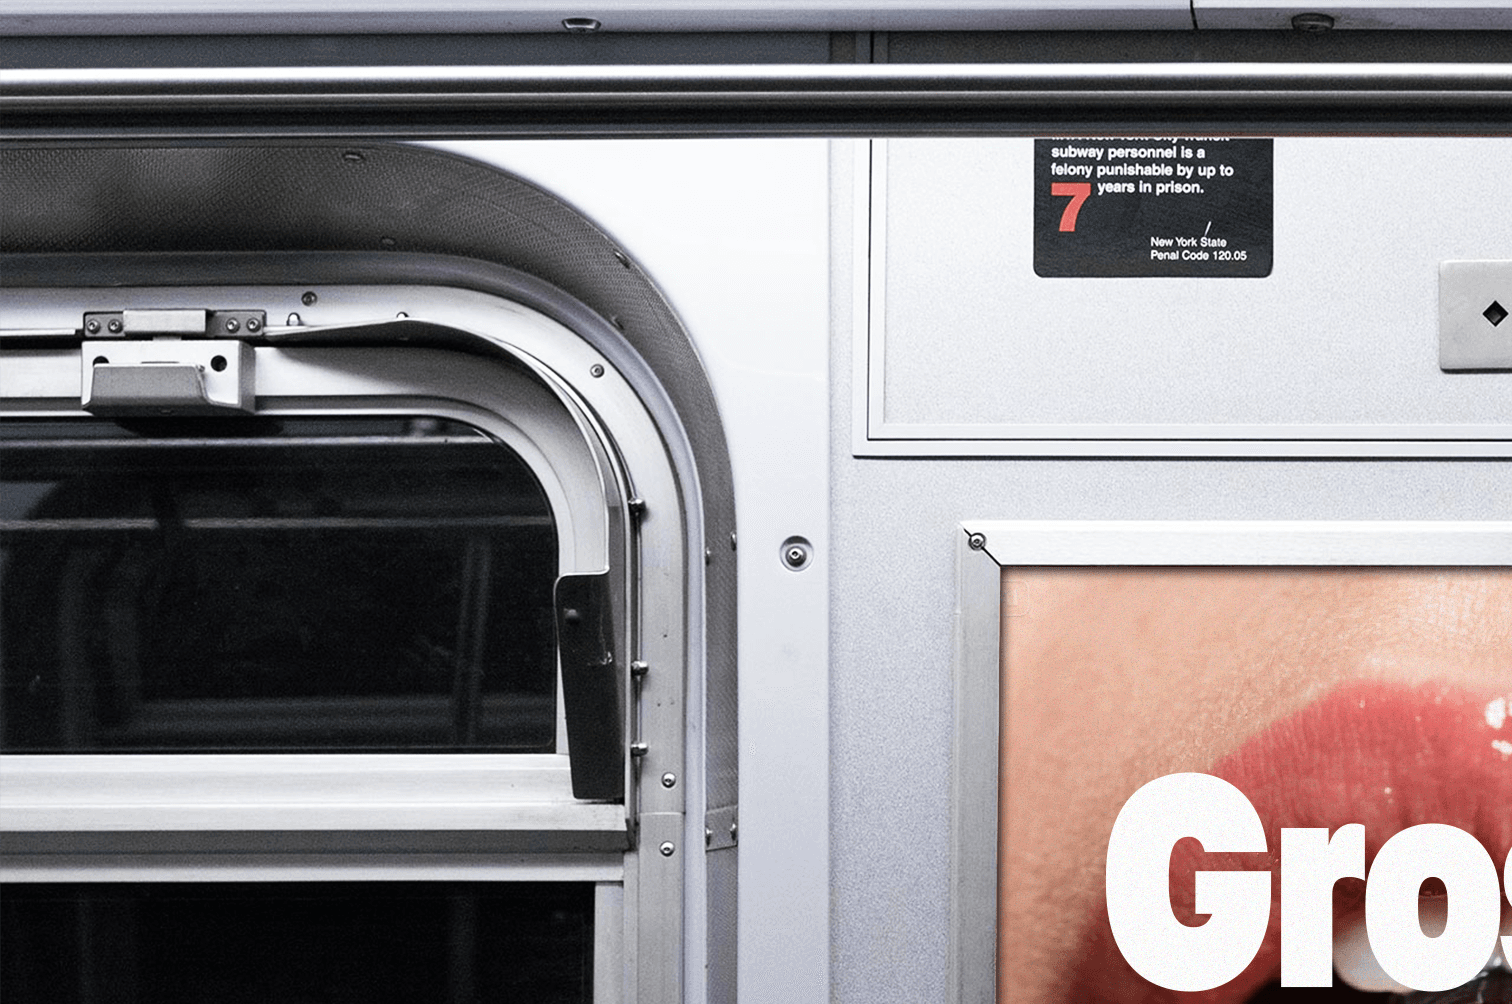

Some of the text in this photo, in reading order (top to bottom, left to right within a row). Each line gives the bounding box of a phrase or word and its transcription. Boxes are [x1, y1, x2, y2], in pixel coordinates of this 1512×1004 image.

[1051, 145, 1206, 161] subway personnel is a
[1051, 163, 1234, 179] felony punishable by up to
[1051, 181, 1205, 232] 7 years in prison.
[1150, 236, 1227, 248] New York State
[1150, 249, 1248, 261] Penal Code 120.05
